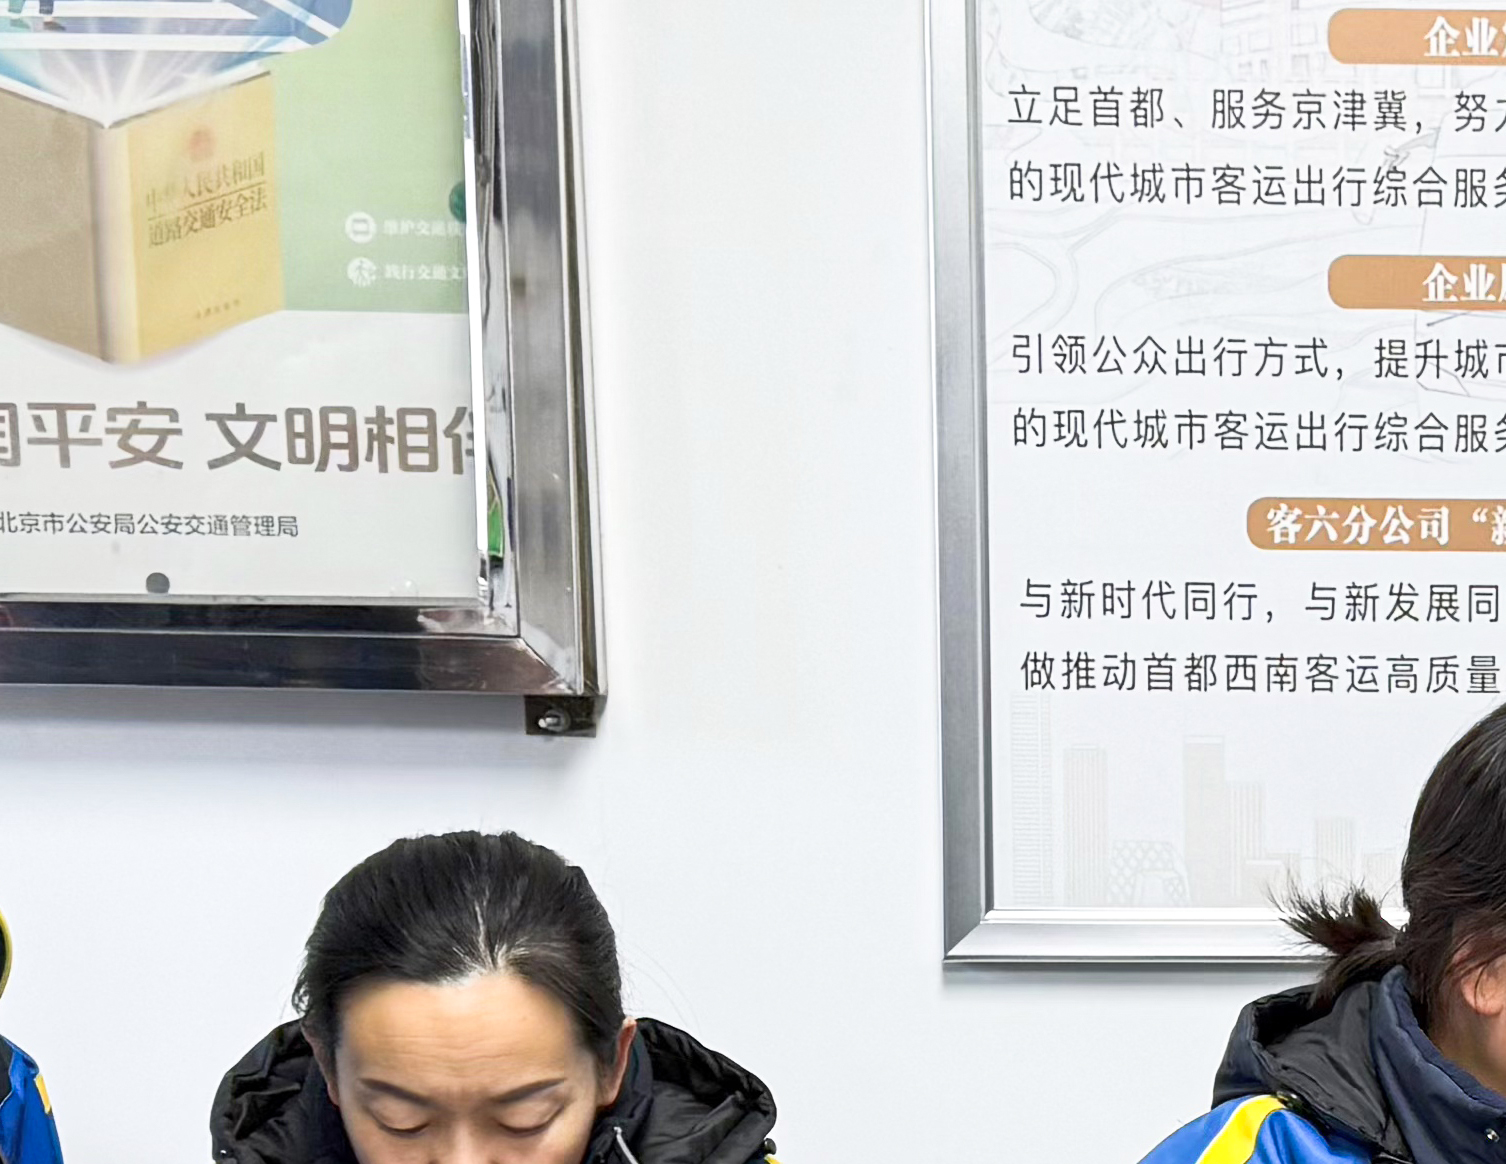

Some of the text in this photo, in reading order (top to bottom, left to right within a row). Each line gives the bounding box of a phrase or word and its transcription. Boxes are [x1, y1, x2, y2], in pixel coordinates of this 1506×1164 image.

[0, 510, 299, 538] 北京市公安局公安交通管理局
